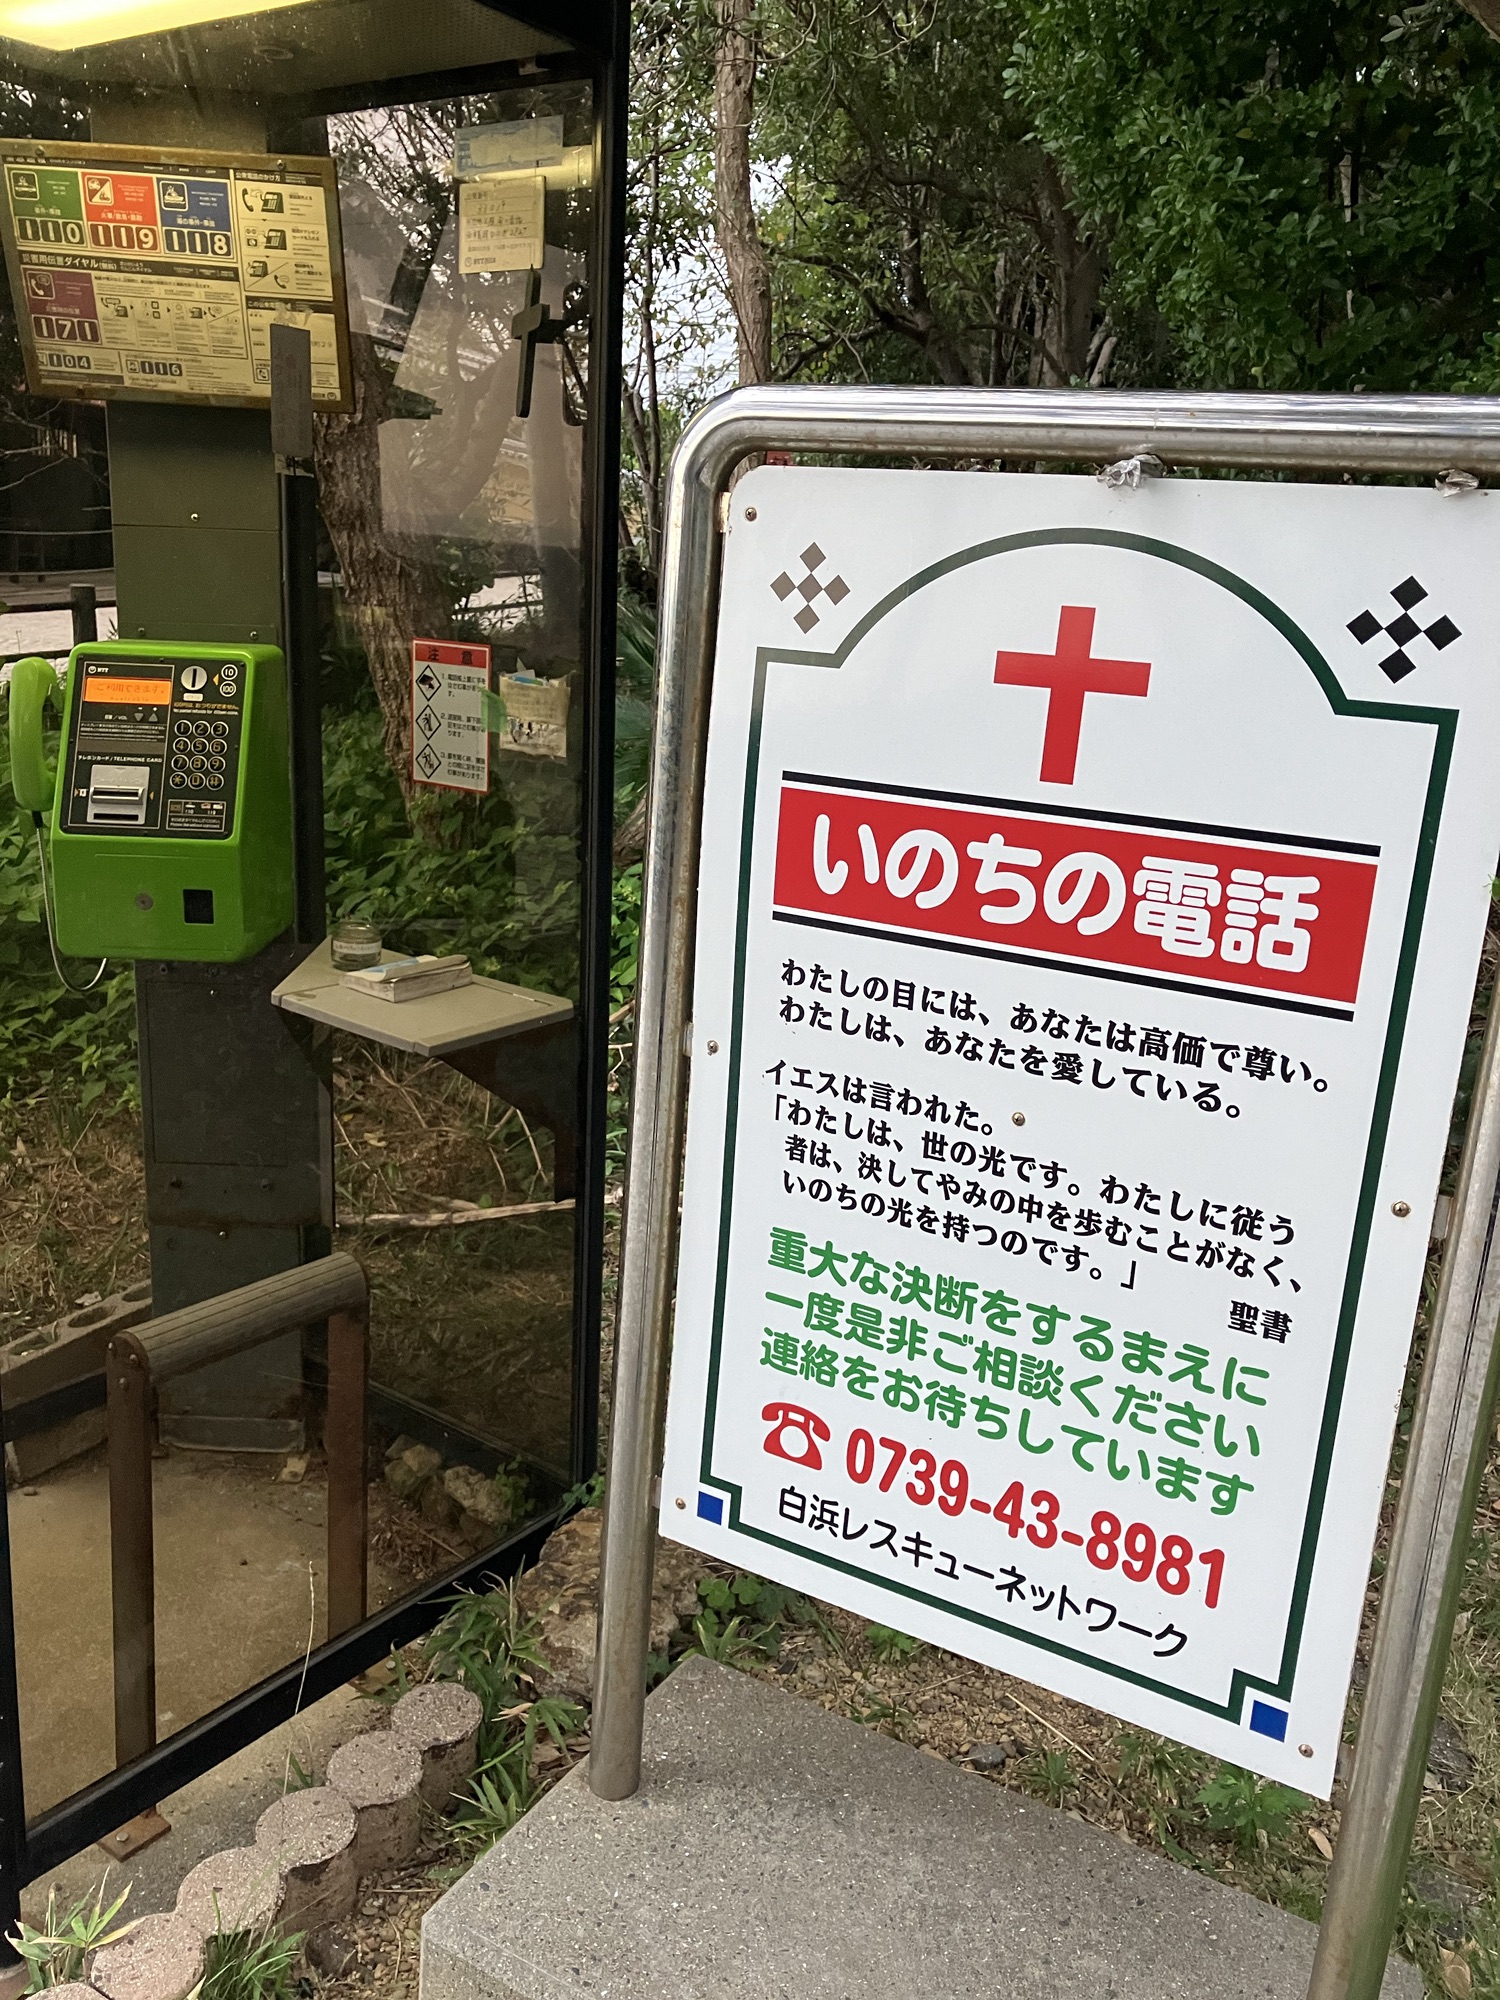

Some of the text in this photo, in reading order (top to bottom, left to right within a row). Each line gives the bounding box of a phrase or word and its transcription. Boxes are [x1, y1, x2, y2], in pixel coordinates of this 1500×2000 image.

[26, 219, 80, 243] 110
[98, 225, 154, 249] 119
[172, 231, 228, 255] 118
[41, 318, 91, 340] 171
[53, 354, 88, 368] 104
[145, 362, 180, 375] 116
[225, 668, 234, 676] 10
[814, 813, 1320, 973] いのちの電話
[780, 996, 1242, 1120] わたしは、あなたを愛している。
[781, 959, 1329, 1093] わたしの目には、あなたは高価で尊い。
[765, 1060, 993, 1136] イエスは言われた。
[774, 1099, 1295, 1245] 「わたしは、世の光です。わたしに従う
[783, 1169, 1137, 1290] いのちの光を持つのです。」
[784, 1134, 1302, 1293] 者は、決してやみの中を歩むことがなく、
[766, 1292, 1260, 1457] 一度是非ご相談ください
[769, 1227, 1270, 1406] 重大な決断をするまえに
[1228, 1300, 1292, 1344] 聖書
[760, 1329, 1254, 1516] 連絡をお待ちしています
[779, 1487, 1188, 1658] 白浜レスキューネットワーク
[847, 1428, 1225, 1609] 0739-43-8981
